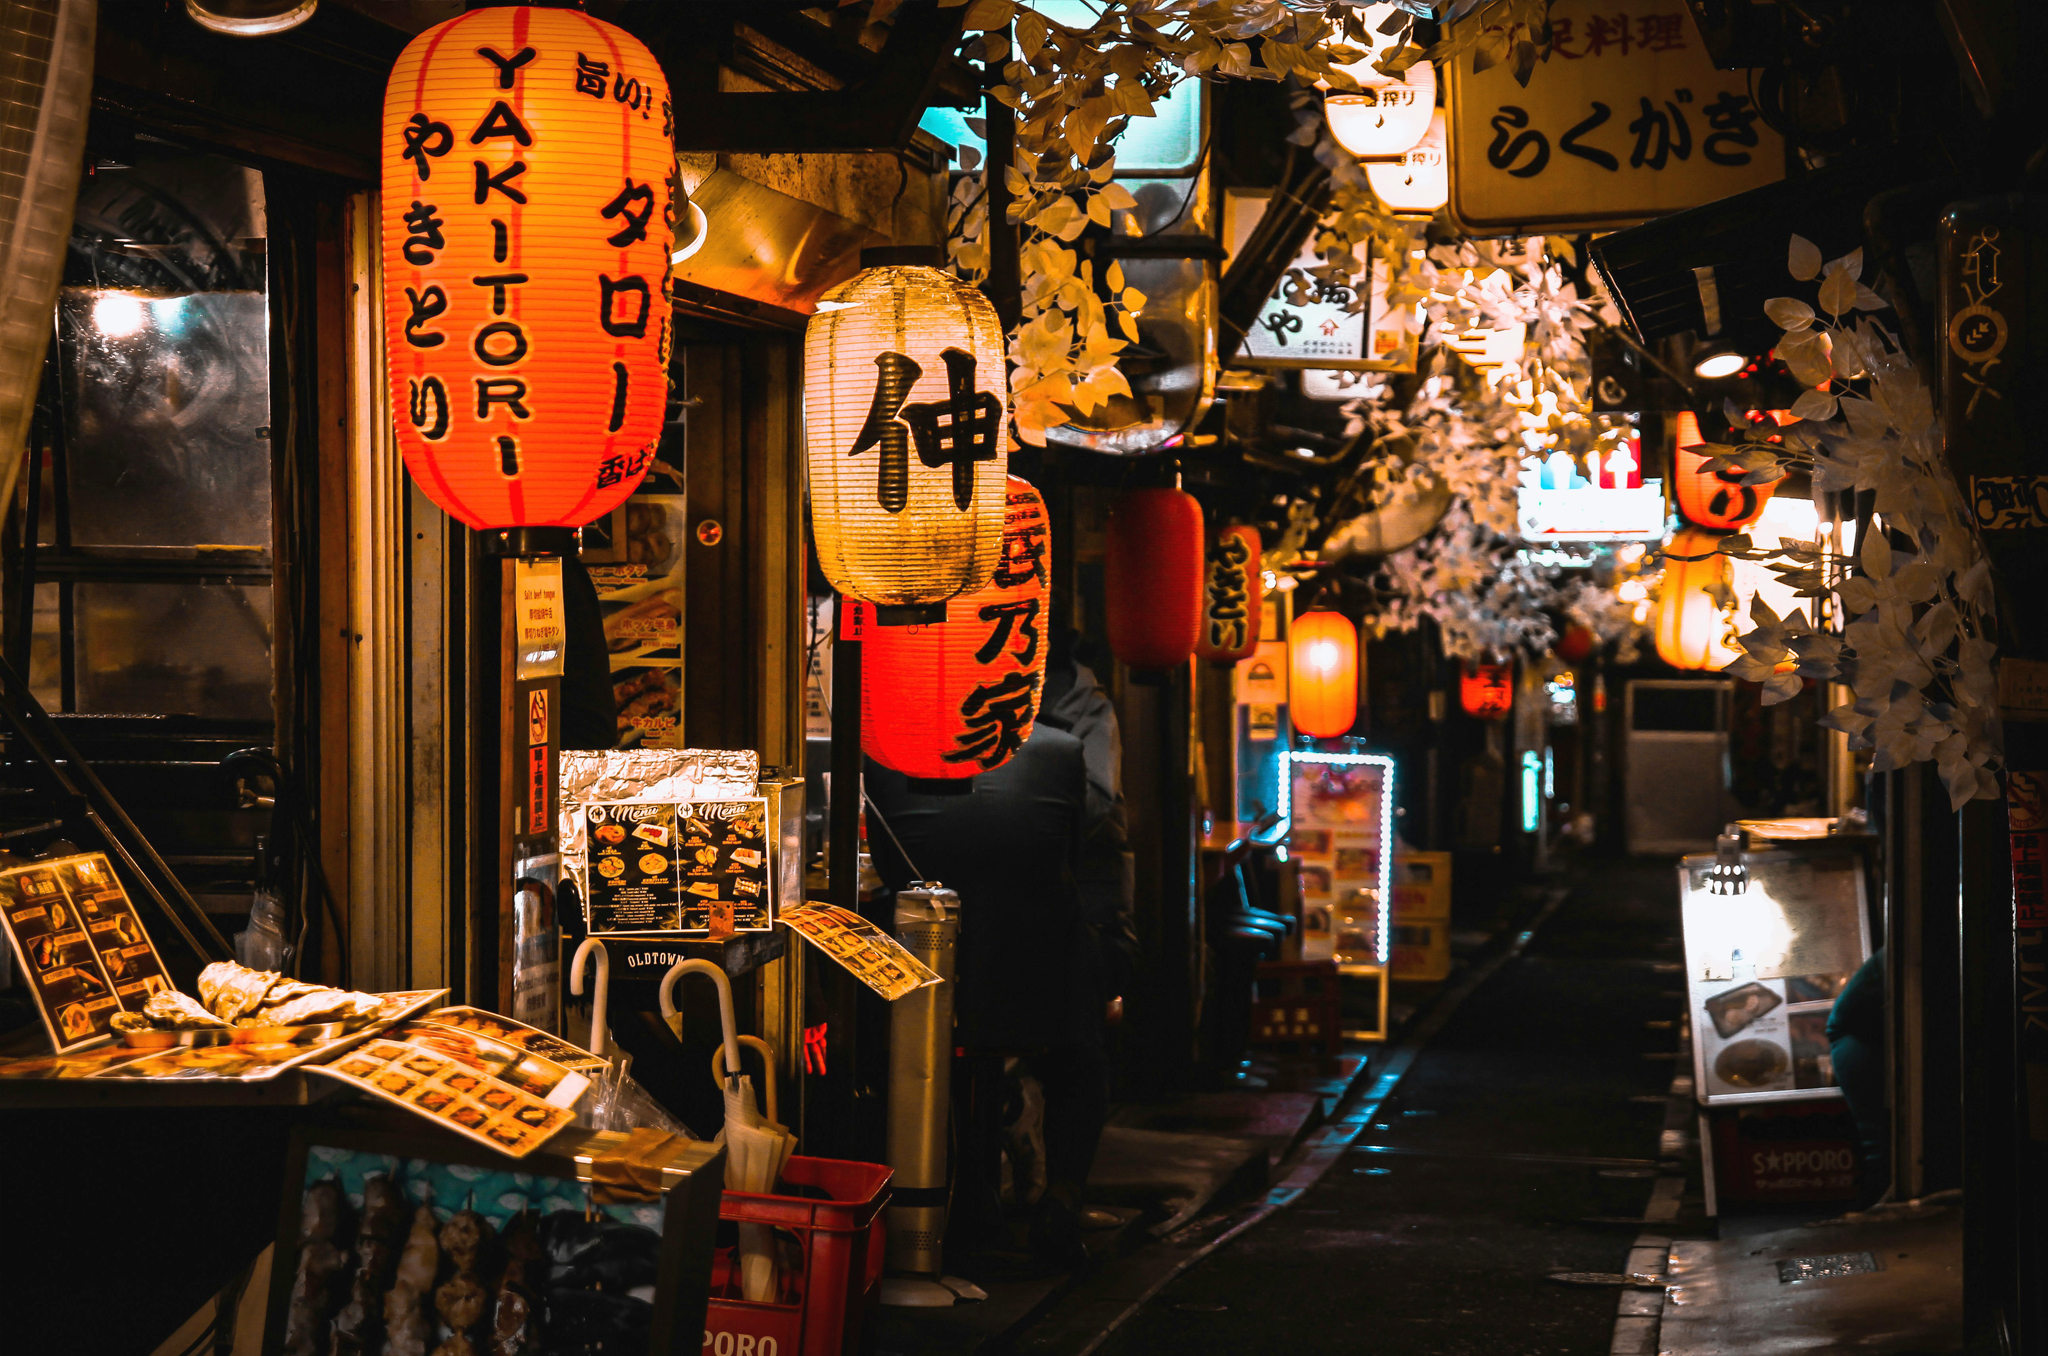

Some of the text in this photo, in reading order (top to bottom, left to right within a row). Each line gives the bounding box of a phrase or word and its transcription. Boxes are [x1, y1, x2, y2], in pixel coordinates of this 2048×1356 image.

[1484, 13, 1687, 60] 足料理
[1487, 88, 1759, 178] らくがき
[402, 113, 454, 440] やきとり
[470, 47, 537, 476] YAKITORI
[600, 178, 656, 432] タロー
[848, 346, 1003, 514] 仲
[1208, 534, 1249, 648] やきとり
[632, 717, 675, 728] 牛カルビ
[610, 805, 659, 822] Menu
[699, 803, 748, 820] Menu
